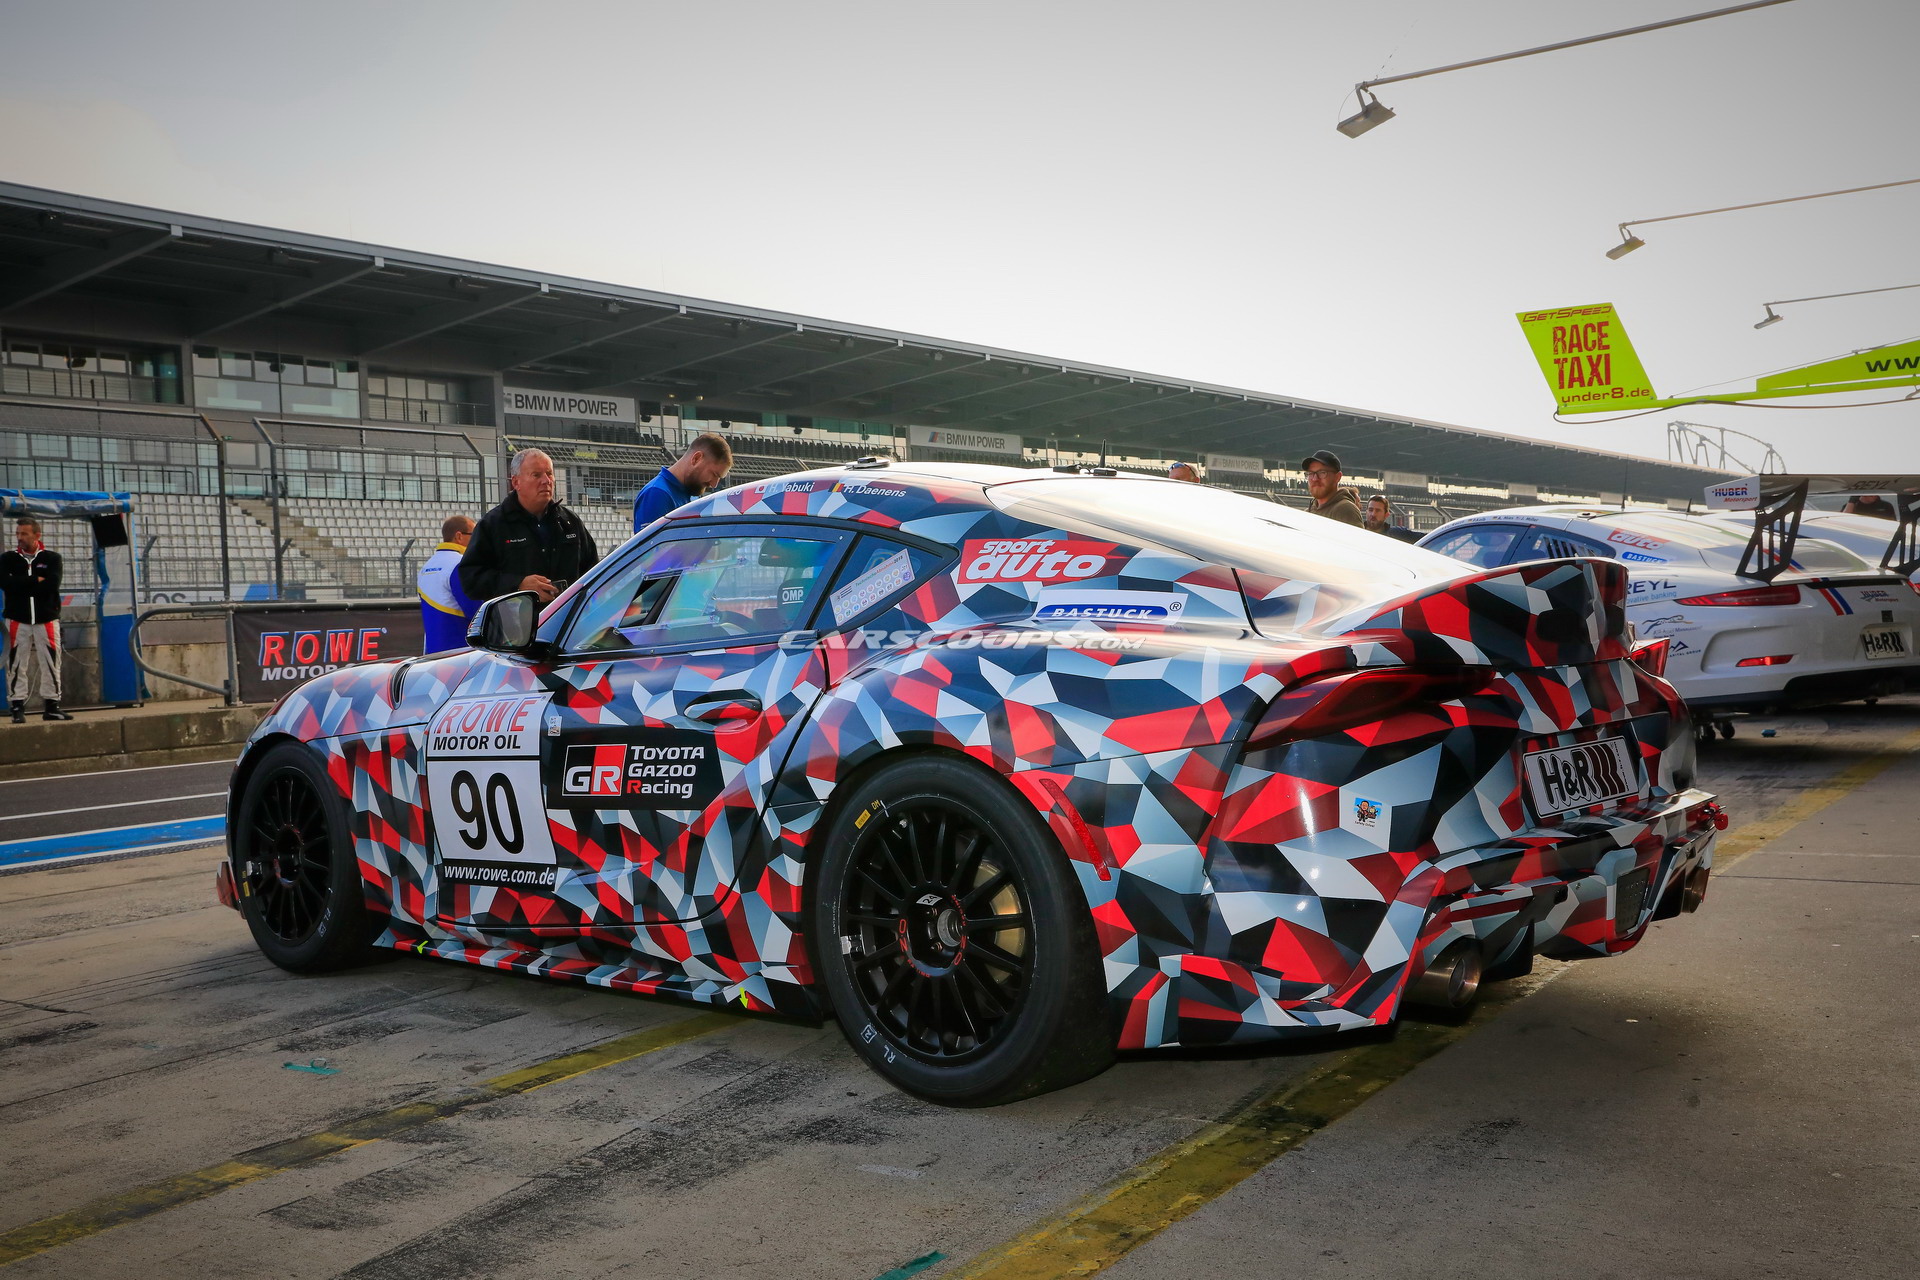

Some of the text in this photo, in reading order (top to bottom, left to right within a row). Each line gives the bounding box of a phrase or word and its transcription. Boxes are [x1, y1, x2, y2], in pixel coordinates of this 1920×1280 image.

[1552, 320, 1610, 355] RACE
[1553, 353, 1611, 389] TAXI
[1561, 387, 1650, 403] under8.de
[514, 393, 618, 416] BMW M POWER
[946, 433, 1005, 449] BMW M POWER
[769, 482, 815, 493] H. Yabuki
[844, 483, 907, 498] H. Daenens
[1715, 487, 1748, 497] HUBER
[979, 540, 1055, 556] sport
[1610, 533, 1664, 550] auto
[966, 554, 1107, 580] auto
[782, 589, 804, 602] OMP
[1651, 591, 1677, 600] banking
[1051, 608, 1152, 619] BASTUCK
[260, 628, 381, 666] ROWE
[1862, 631, 1892, 653] H&R
[434, 697, 541, 734] ROWE
[433, 735, 521, 750] MOTOR OIL
[631, 745, 705, 760] TOYOTA
[628, 763, 697, 777] GAZOO
[565, 765, 622, 793] GR
[1537, 748, 1602, 810] H&R
[626, 780, 694, 799] Racing
[450, 769, 525, 855] 90
[444, 865, 555, 886] www.rowe.com.de
